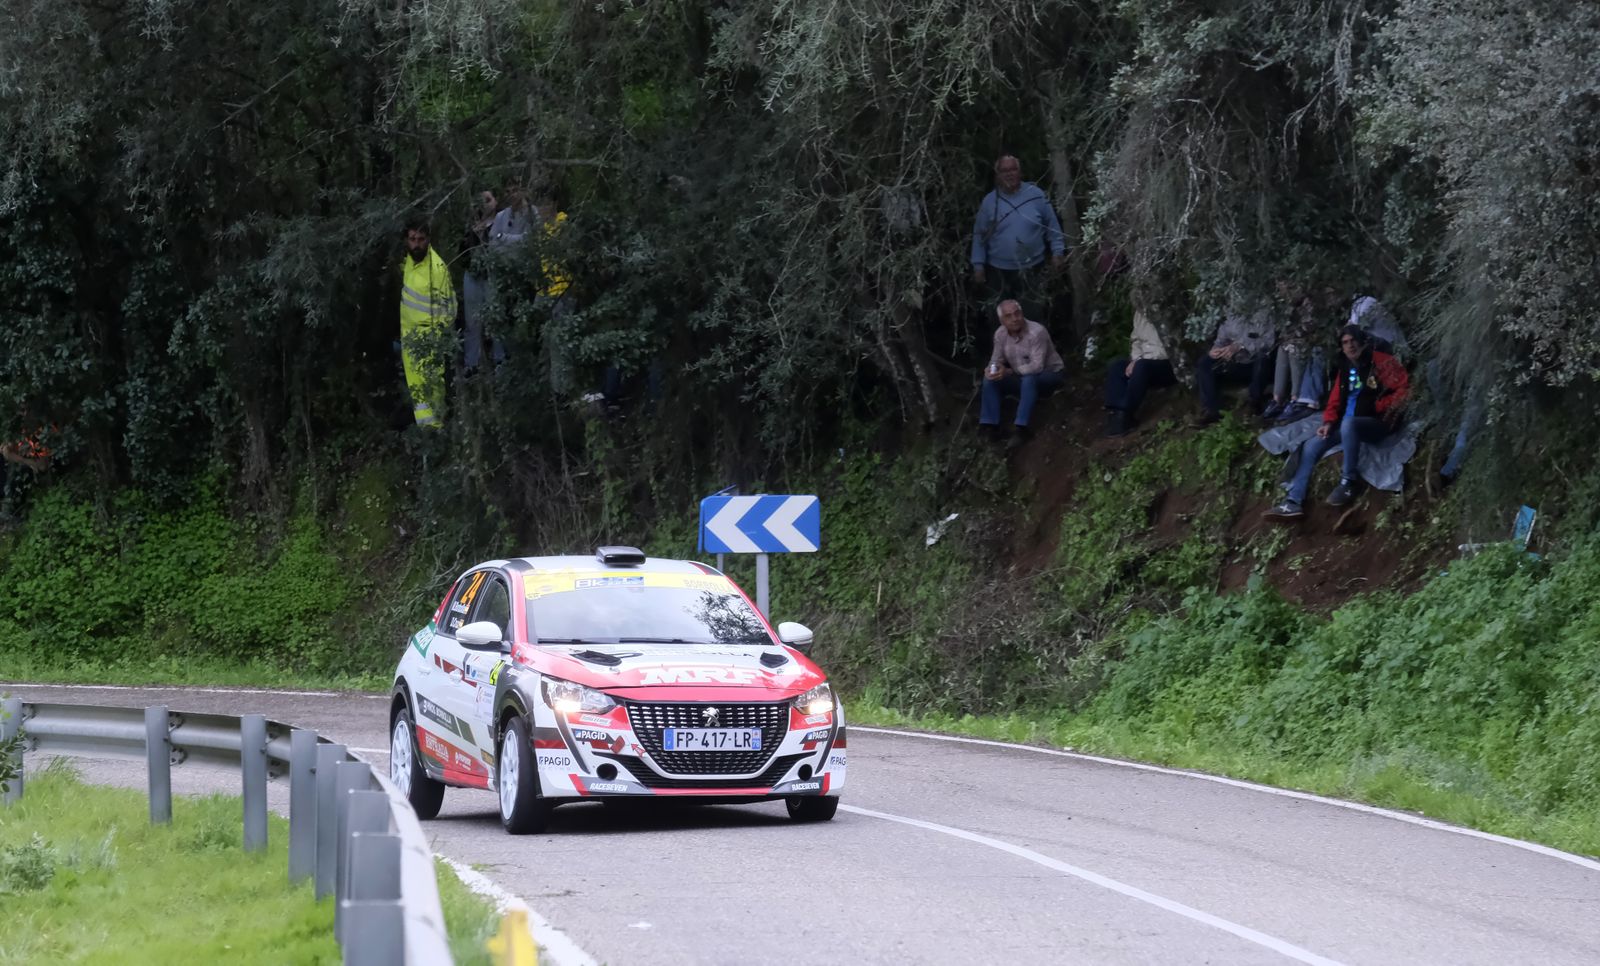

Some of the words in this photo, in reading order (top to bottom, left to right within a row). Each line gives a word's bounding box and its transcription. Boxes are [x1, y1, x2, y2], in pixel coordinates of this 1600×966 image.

[460, 571, 486, 604] 24
[639, 667, 757, 685] MRF
[581, 731, 607, 740] PAGID
[676, 731, 752, 748] FP-417-LR
[812, 731, 828, 740] PAGID
[544, 756, 571, 766] PAGID
[589, 782, 628, 792] RACESEVEN
[791, 782, 820, 791] RACESEVEN
